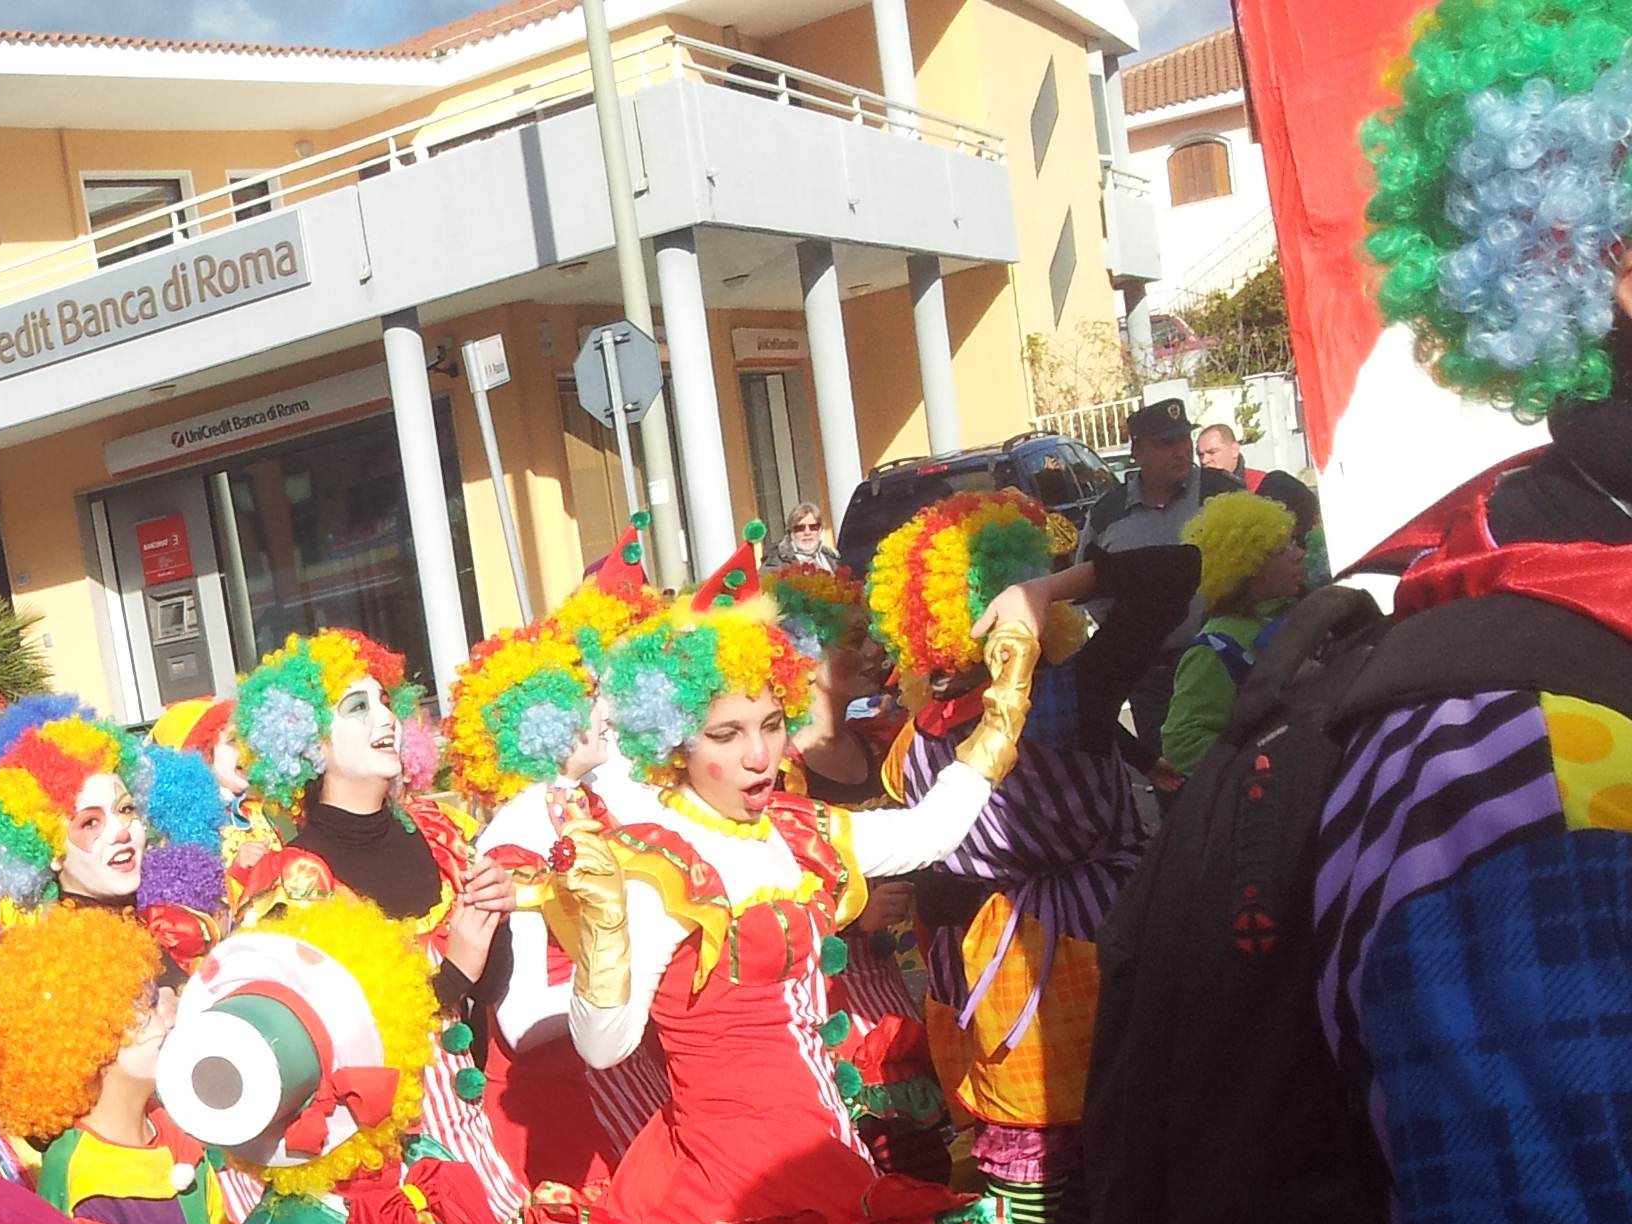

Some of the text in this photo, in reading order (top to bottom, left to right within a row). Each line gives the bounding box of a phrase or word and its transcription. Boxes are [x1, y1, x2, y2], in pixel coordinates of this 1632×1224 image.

[56, 285, 158, 345] Banca
[162, 262, 192, 313] di
[194, 240, 299, 304] Roma
[185, 400, 310, 443] UniCredit Banca di Roma
